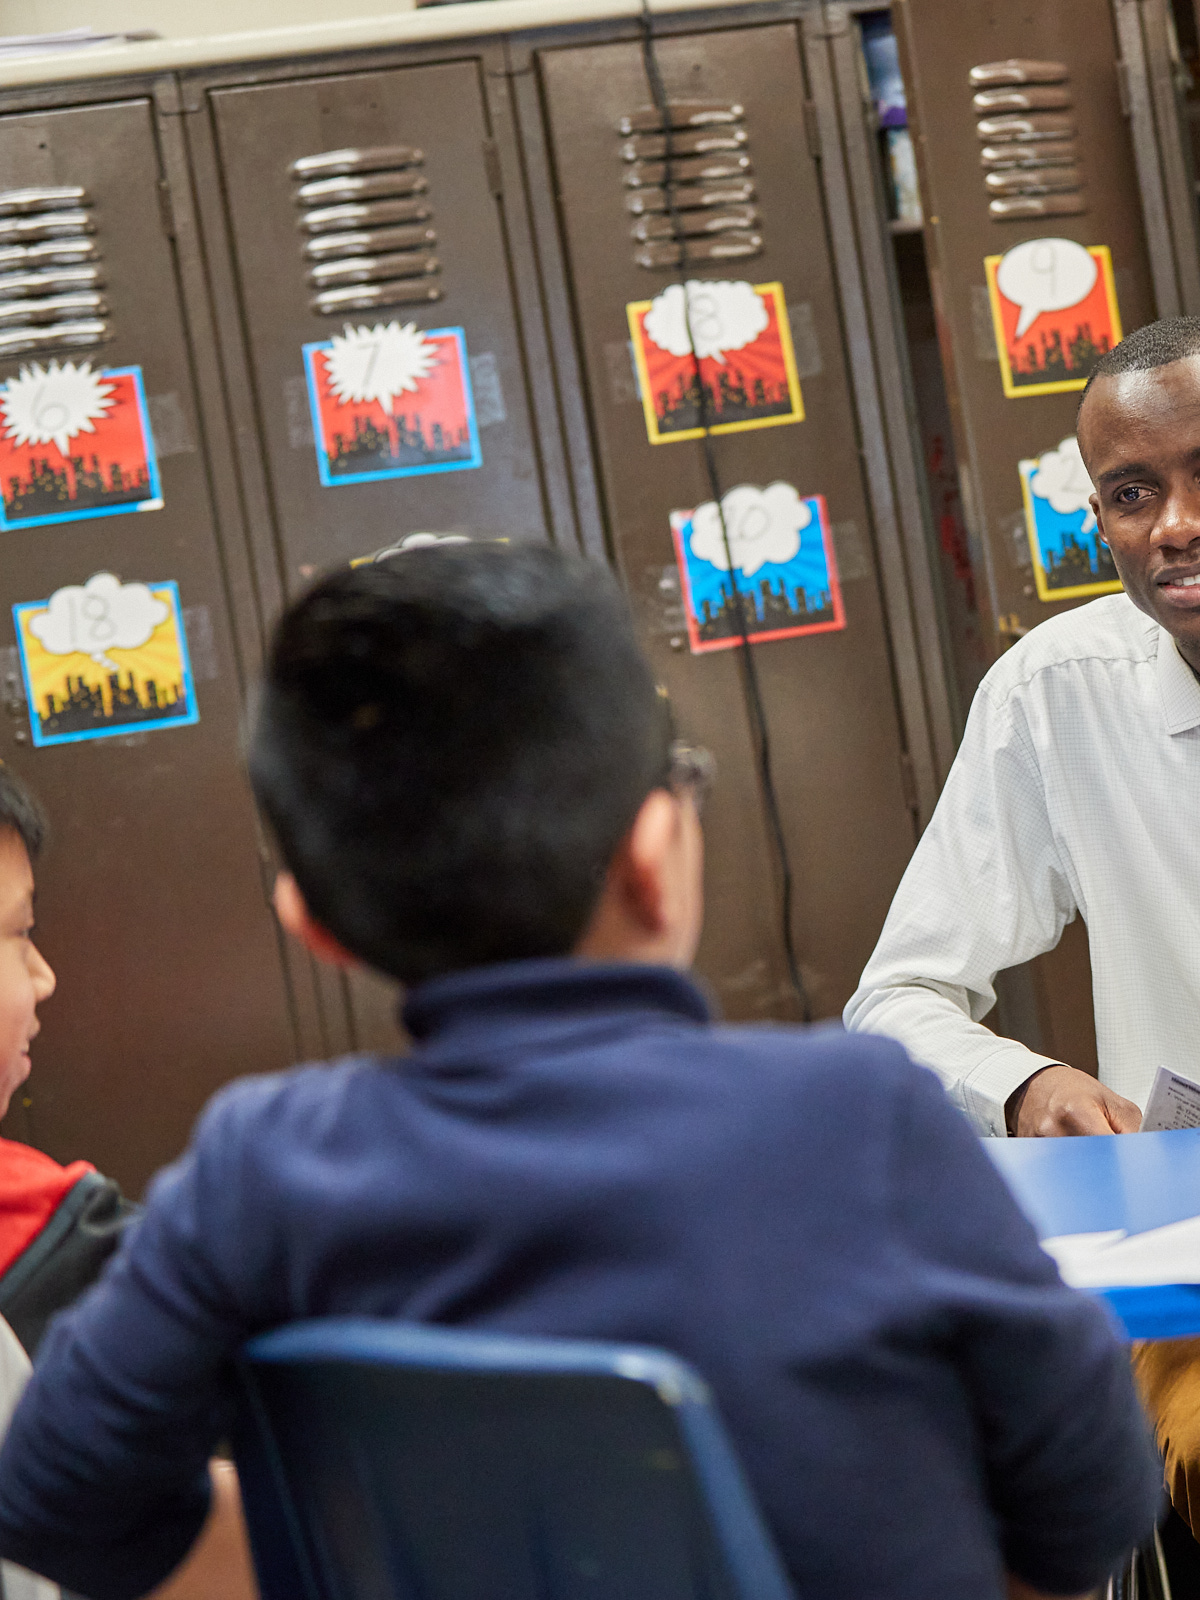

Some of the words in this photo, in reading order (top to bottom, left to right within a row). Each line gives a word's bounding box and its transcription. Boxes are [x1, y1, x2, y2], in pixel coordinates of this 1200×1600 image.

[1029, 244, 1057, 299] 9
[692, 292, 724, 342] 8
[356, 340, 380, 388] 7
[30, 382, 71, 431] 6
[68, 593, 118, 643] 18
